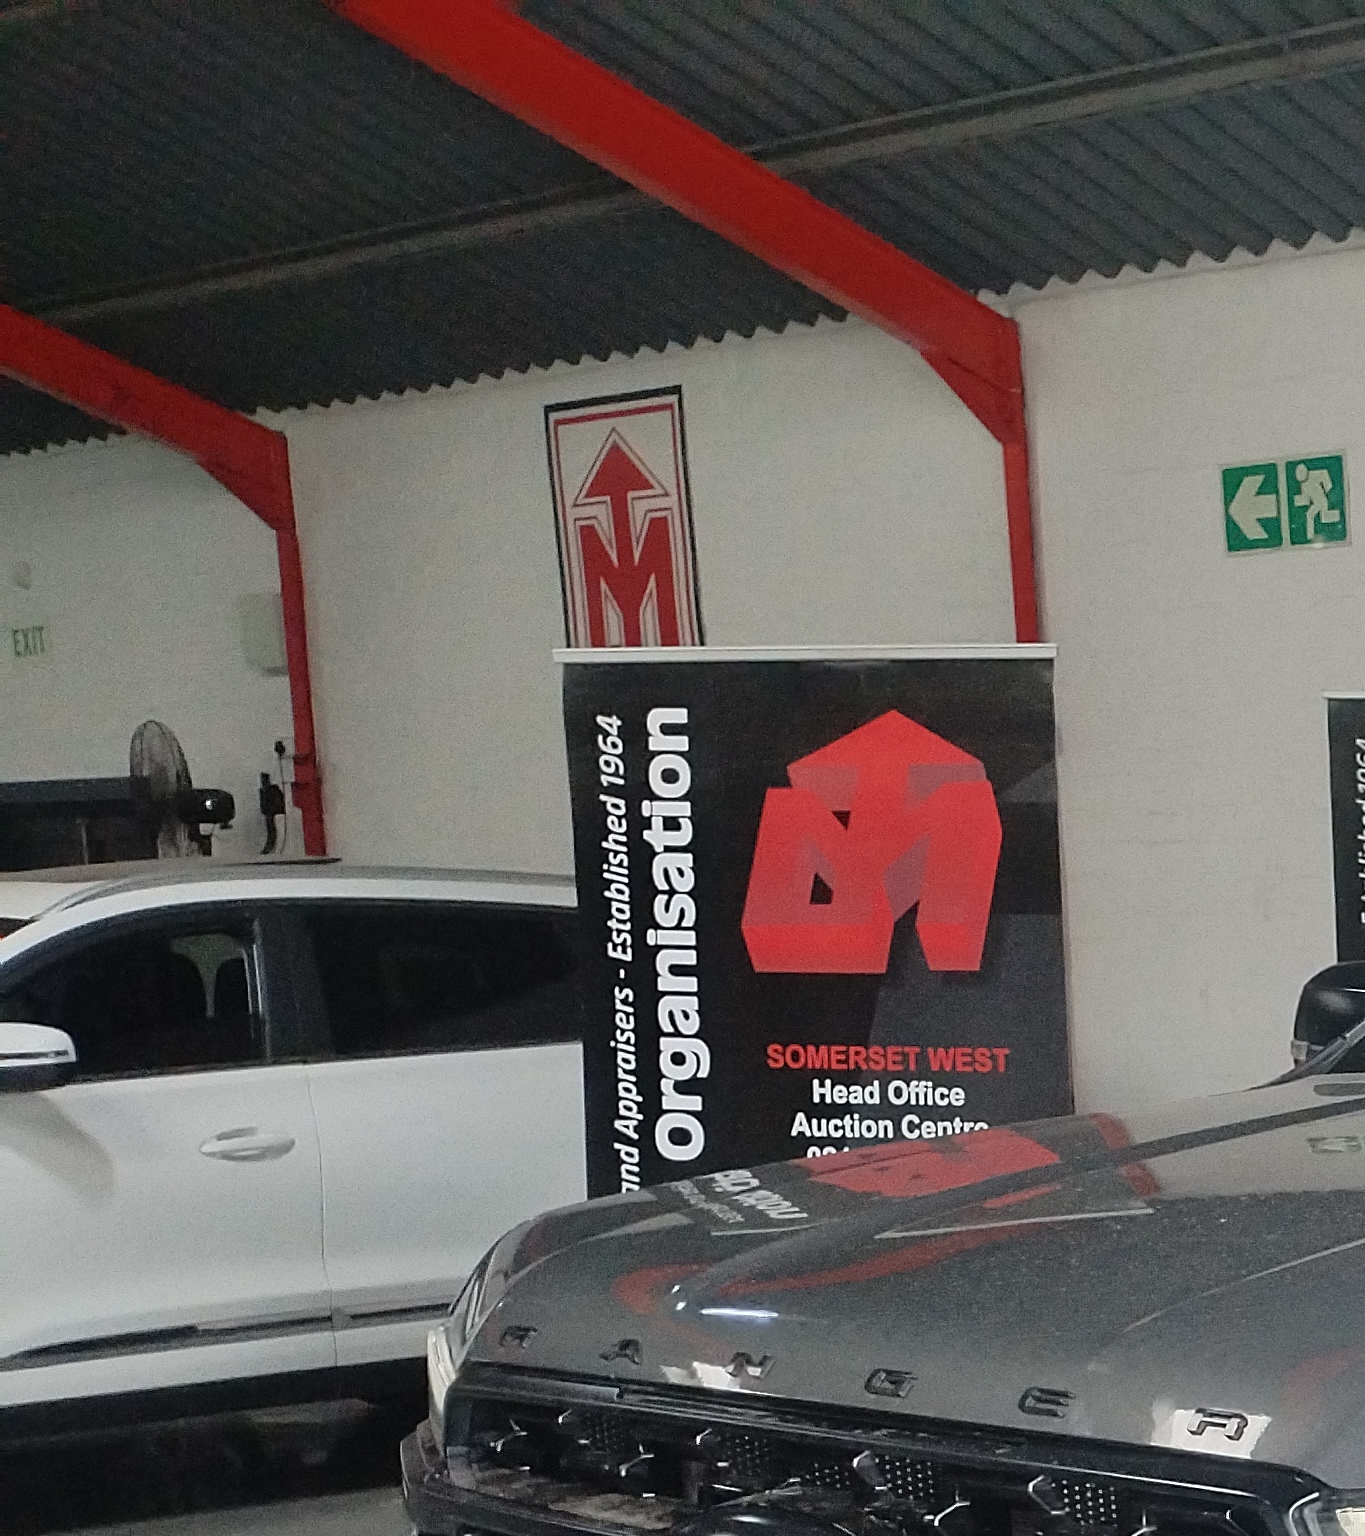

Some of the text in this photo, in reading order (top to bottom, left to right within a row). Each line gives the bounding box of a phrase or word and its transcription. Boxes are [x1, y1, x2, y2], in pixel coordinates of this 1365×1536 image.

[596, 714, 626, 787] 1964
[599, 794, 633, 961] Established
[642, 707, 711, 1161] Organisation
[610, 985, 644, 1140] Appraisers
[766, 1043, 1010, 1073] SOMERSET WEST
[812, 1078, 966, 1107] Head Office
[790, 1111, 894, 1139] Auction
